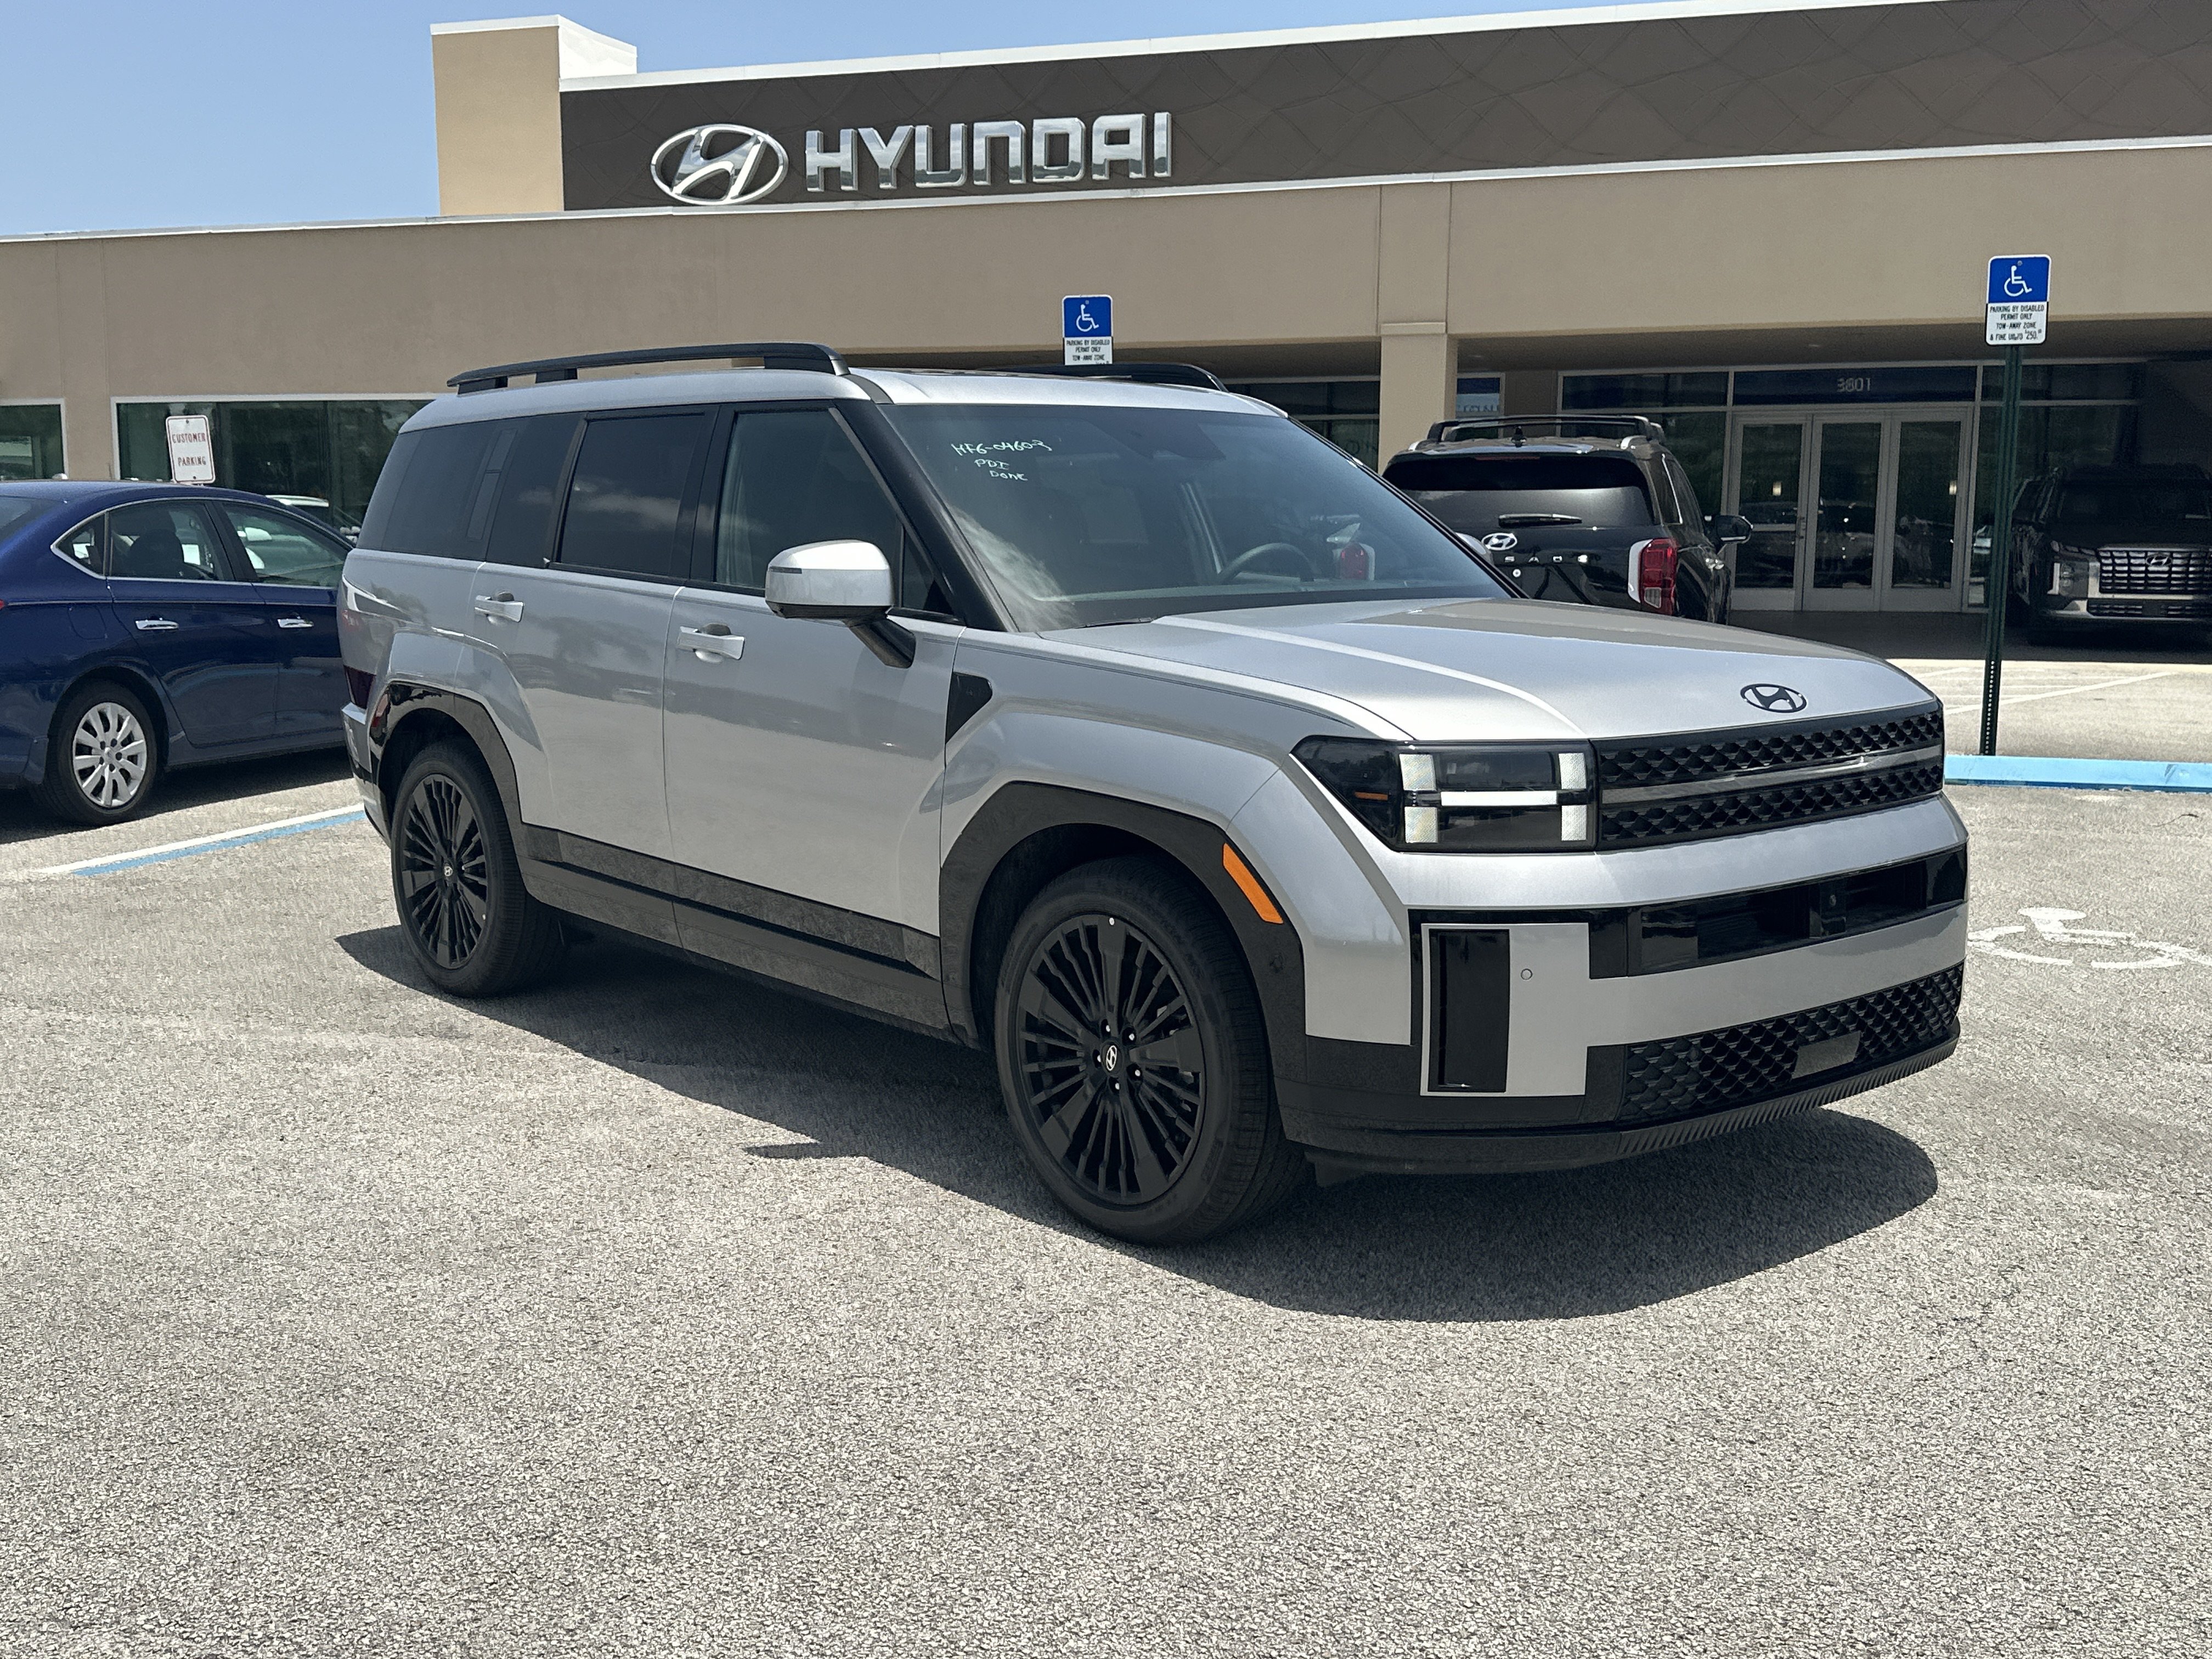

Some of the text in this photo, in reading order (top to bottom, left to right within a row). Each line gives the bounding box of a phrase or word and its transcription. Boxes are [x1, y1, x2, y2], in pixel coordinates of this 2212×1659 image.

[805, 112, 1172, 193] HYUNDAI
[172, 432, 206, 444] CUSTOMER
[177, 456, 206, 467] PARKING
[974, 459, 1010, 471] PDI
